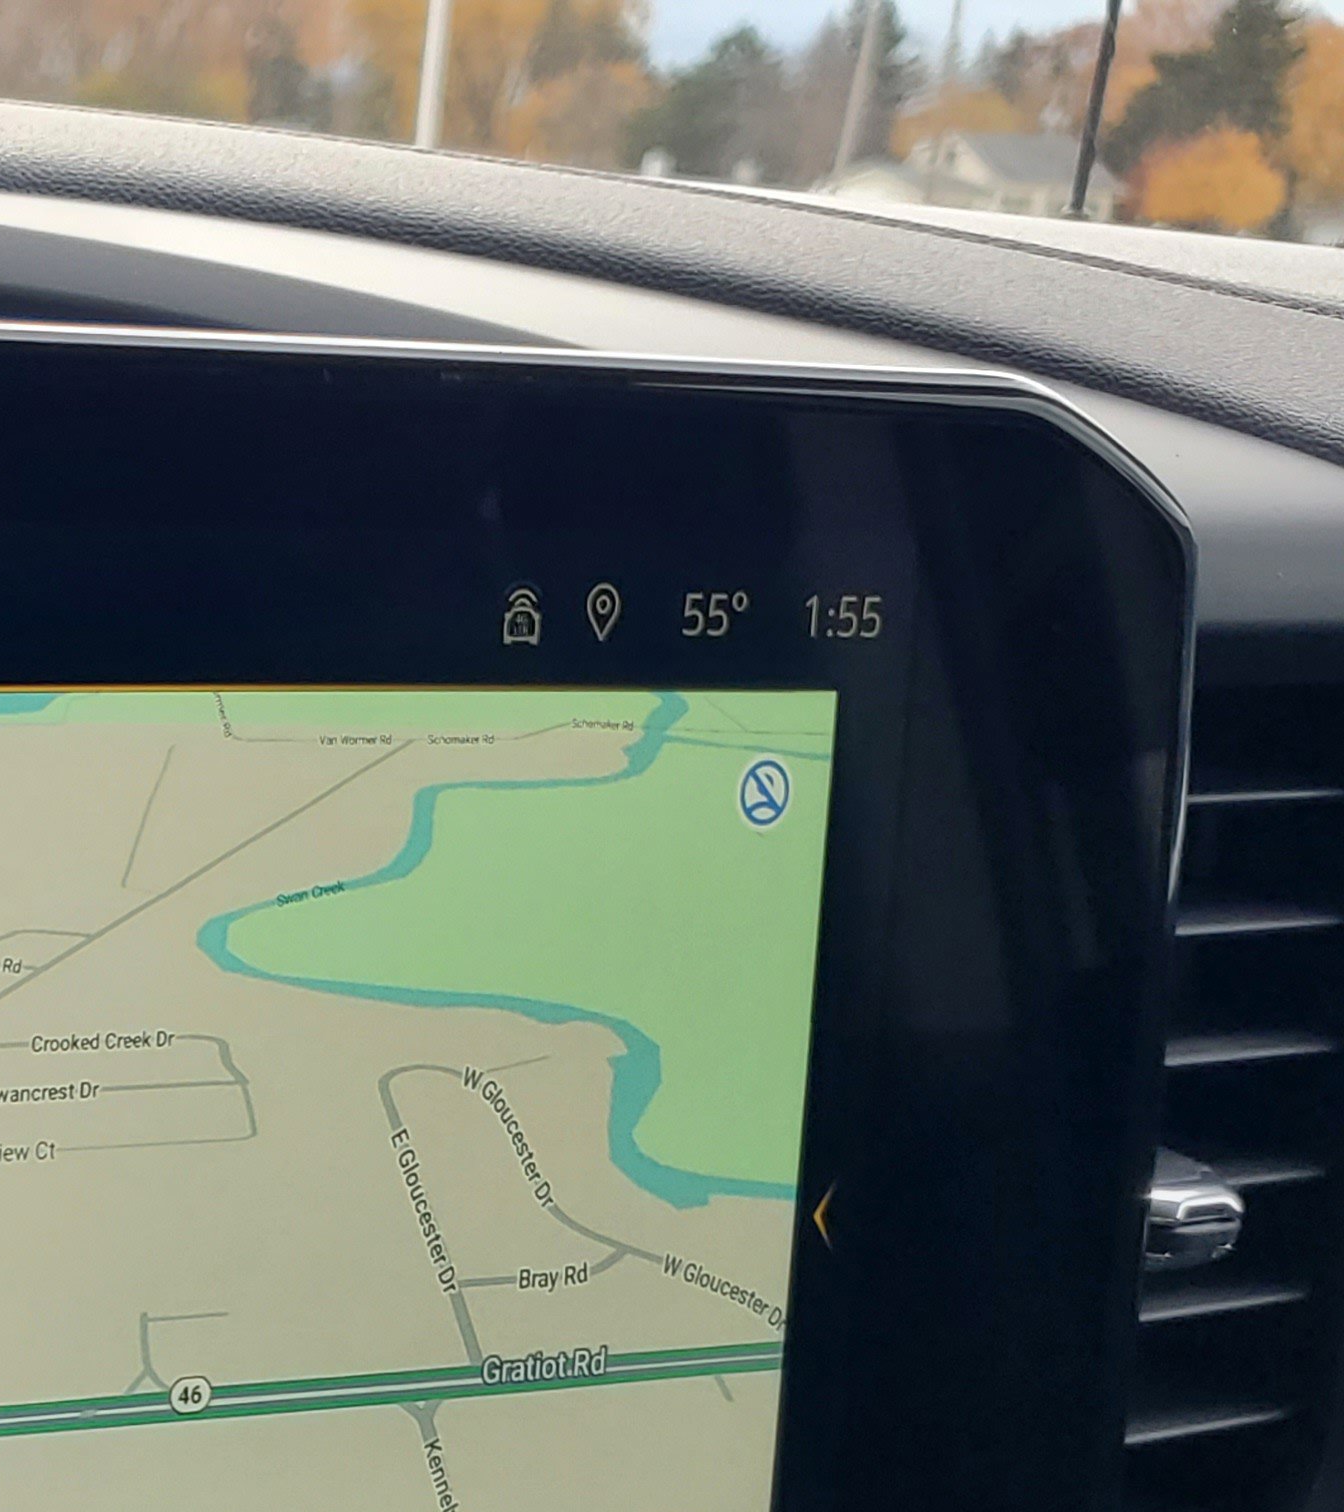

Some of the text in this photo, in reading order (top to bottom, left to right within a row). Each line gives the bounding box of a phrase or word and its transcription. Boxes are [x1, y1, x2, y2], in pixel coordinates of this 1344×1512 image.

[682, 591, 750, 637] 55°
[805, 594, 883, 638] 1:55
[319, 734, 392, 746] Van Wormer Rd
[482, 734, 495, 745] Rd
[3, 958, 22, 974] Rd
[30, 1030, 175, 1053] Crooked Creek Dr
[80, 1082, 100, 1099] Dr
[461, 1066, 554, 1208] W Gloucester Dr
[35, 1141, 56, 1160] Ct
[390, 1128, 456, 1294] E Gloucester Dr
[518, 1262, 588, 1292] Bray Rd
[662, 1254, 787, 1331] W Gloucester Dr
[481, 1345, 608, 1385] Gratiot Rd
[178, 1384, 203, 1405] 46
